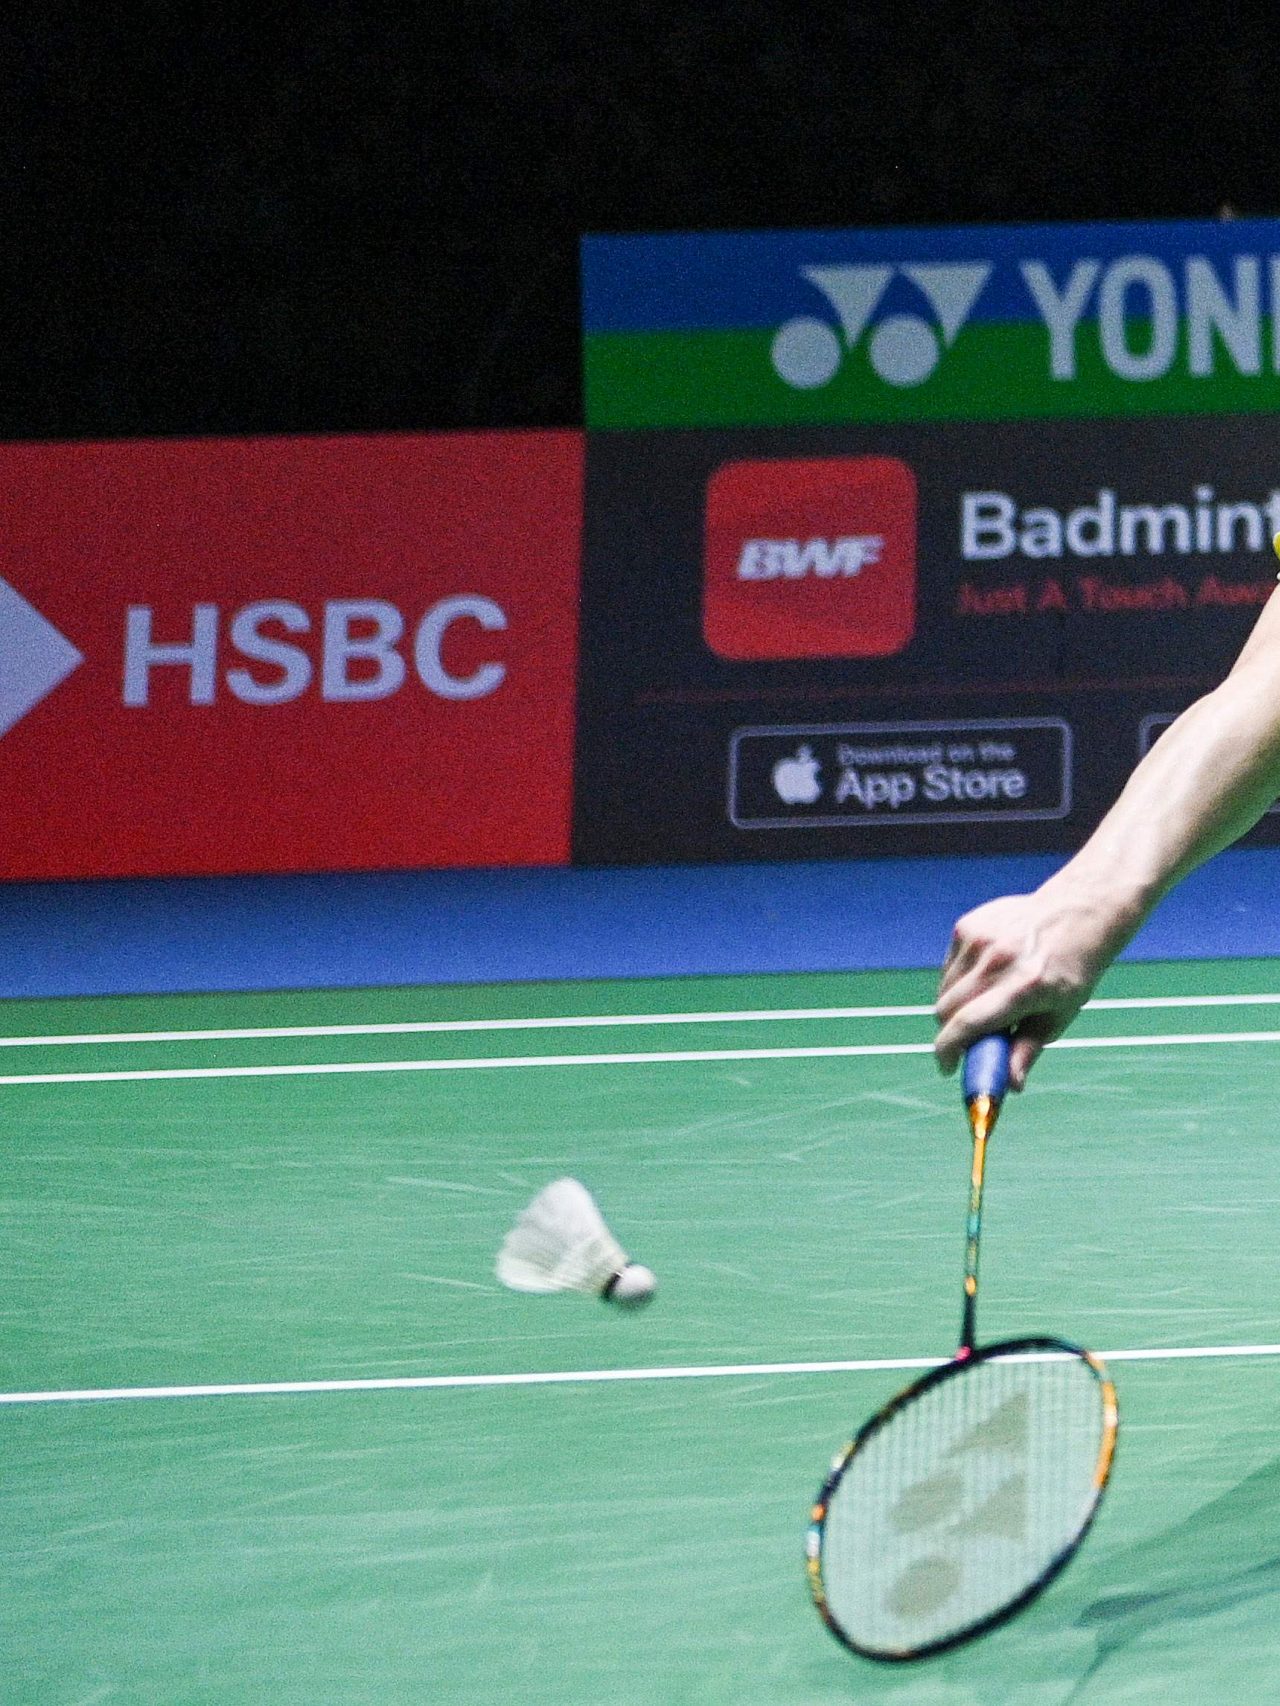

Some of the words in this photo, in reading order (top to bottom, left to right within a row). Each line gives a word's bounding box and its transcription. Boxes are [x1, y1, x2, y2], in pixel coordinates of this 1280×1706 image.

[737, 535, 885, 581] BWF
[958, 582, 1026, 613] Just
[1037, 578, 1067, 610] A
[1078, 575, 1188, 611] Touch
[121, 594, 507, 707] HSBC
[836, 743, 942, 765] Download
[947, 743, 974, 763] on
[978, 741, 1016, 761] the
[835, 766, 916, 808] App
[923, 761, 1027, 800] Store
